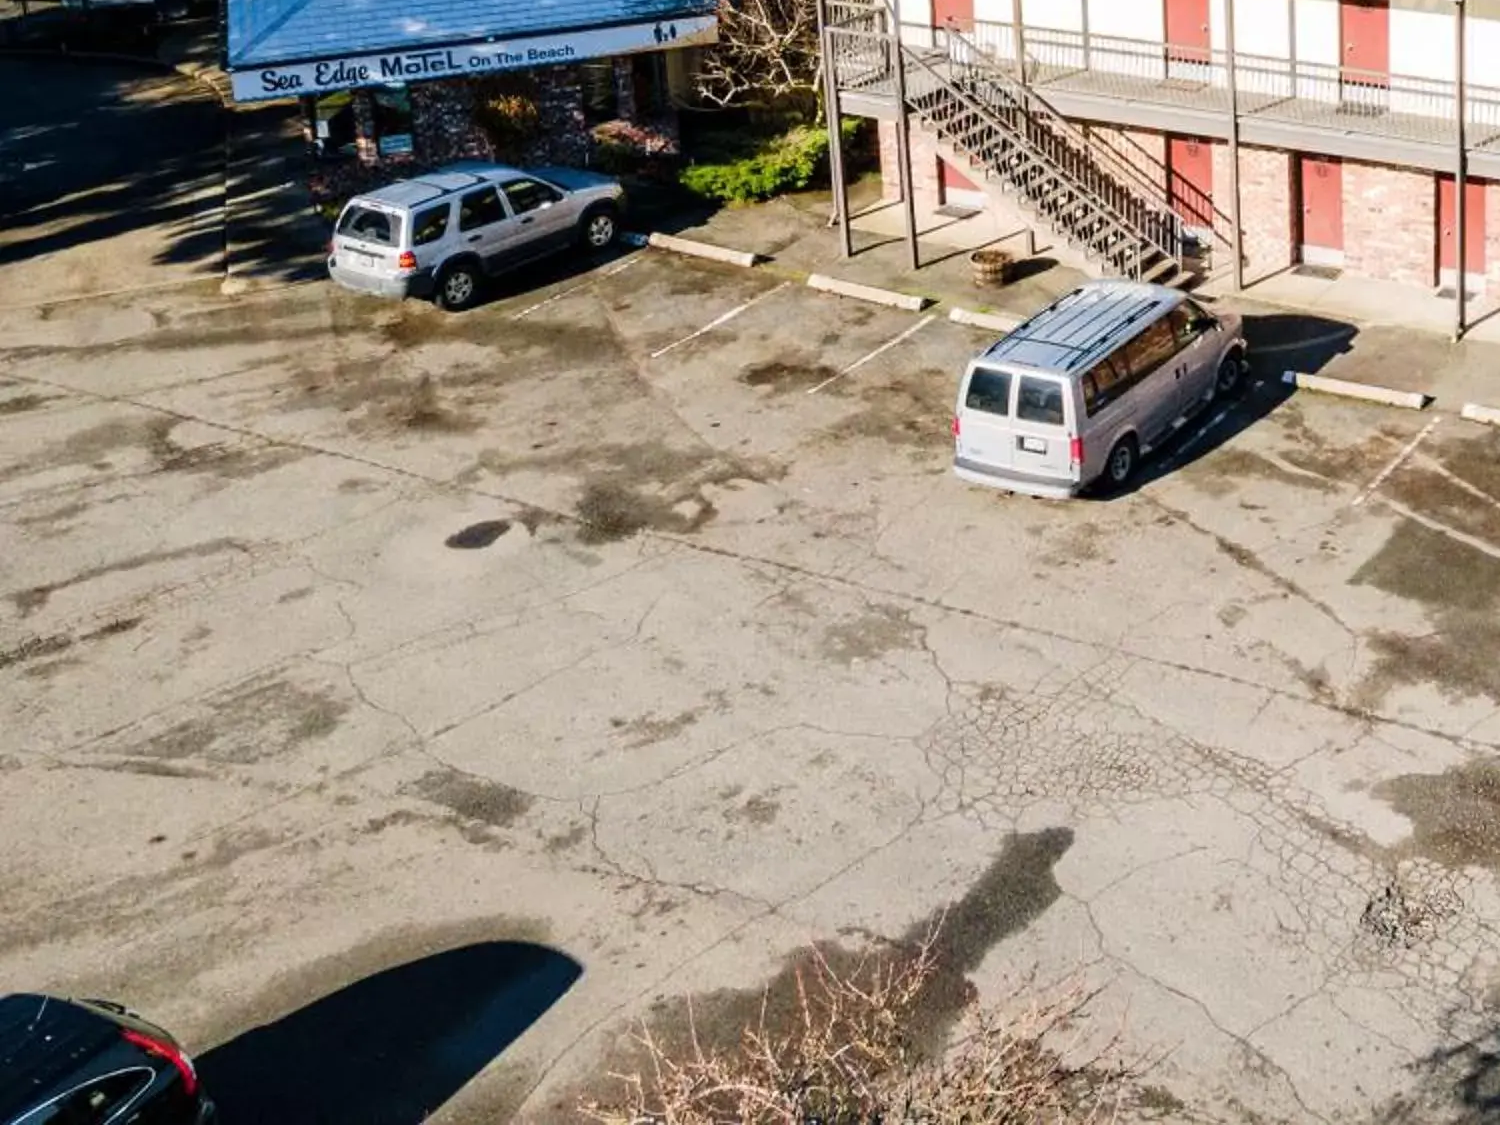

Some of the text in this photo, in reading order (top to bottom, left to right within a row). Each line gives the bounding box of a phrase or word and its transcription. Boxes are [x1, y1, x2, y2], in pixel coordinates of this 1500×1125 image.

[261, 70, 303, 92] Sea
[315, 61, 369, 87] Edge
[469, 55, 491, 68] On
[496, 52, 523, 65] The
[528, 44, 575, 61] Beach
